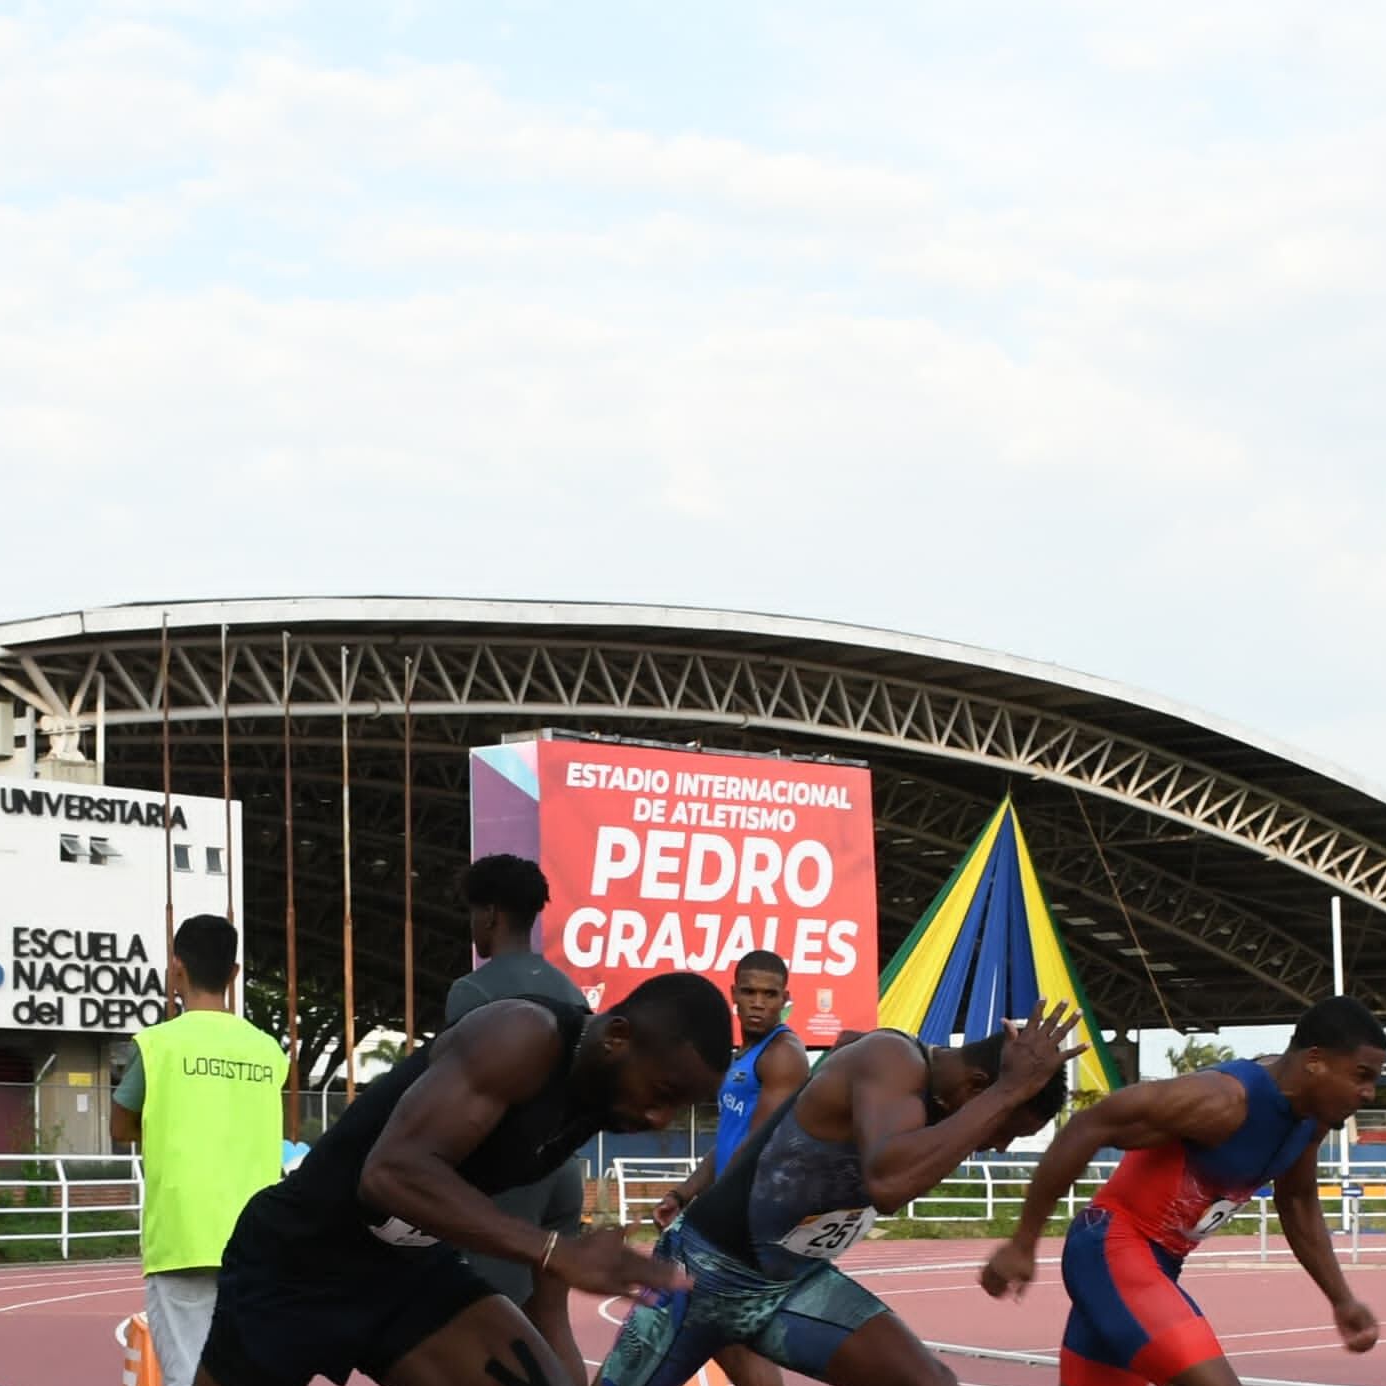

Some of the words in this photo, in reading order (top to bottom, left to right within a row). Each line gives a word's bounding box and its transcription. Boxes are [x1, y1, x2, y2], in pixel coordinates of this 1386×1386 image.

[566, 761, 670, 793] ESTADIO
[674, 771, 852, 810] INTERNACIONAL
[633, 797, 667, 823] DE
[670, 801, 796, 833] ATLETISMO
[590, 825, 834, 909] PEDRO
[12, 926, 149, 963] ESCUELA
[562, 906, 859, 977] GRAJALES
[12, 959, 169, 996] NACIONA
[12, 994, 64, 1026] del
[182, 1056, 274, 1085] LOGISTICA
